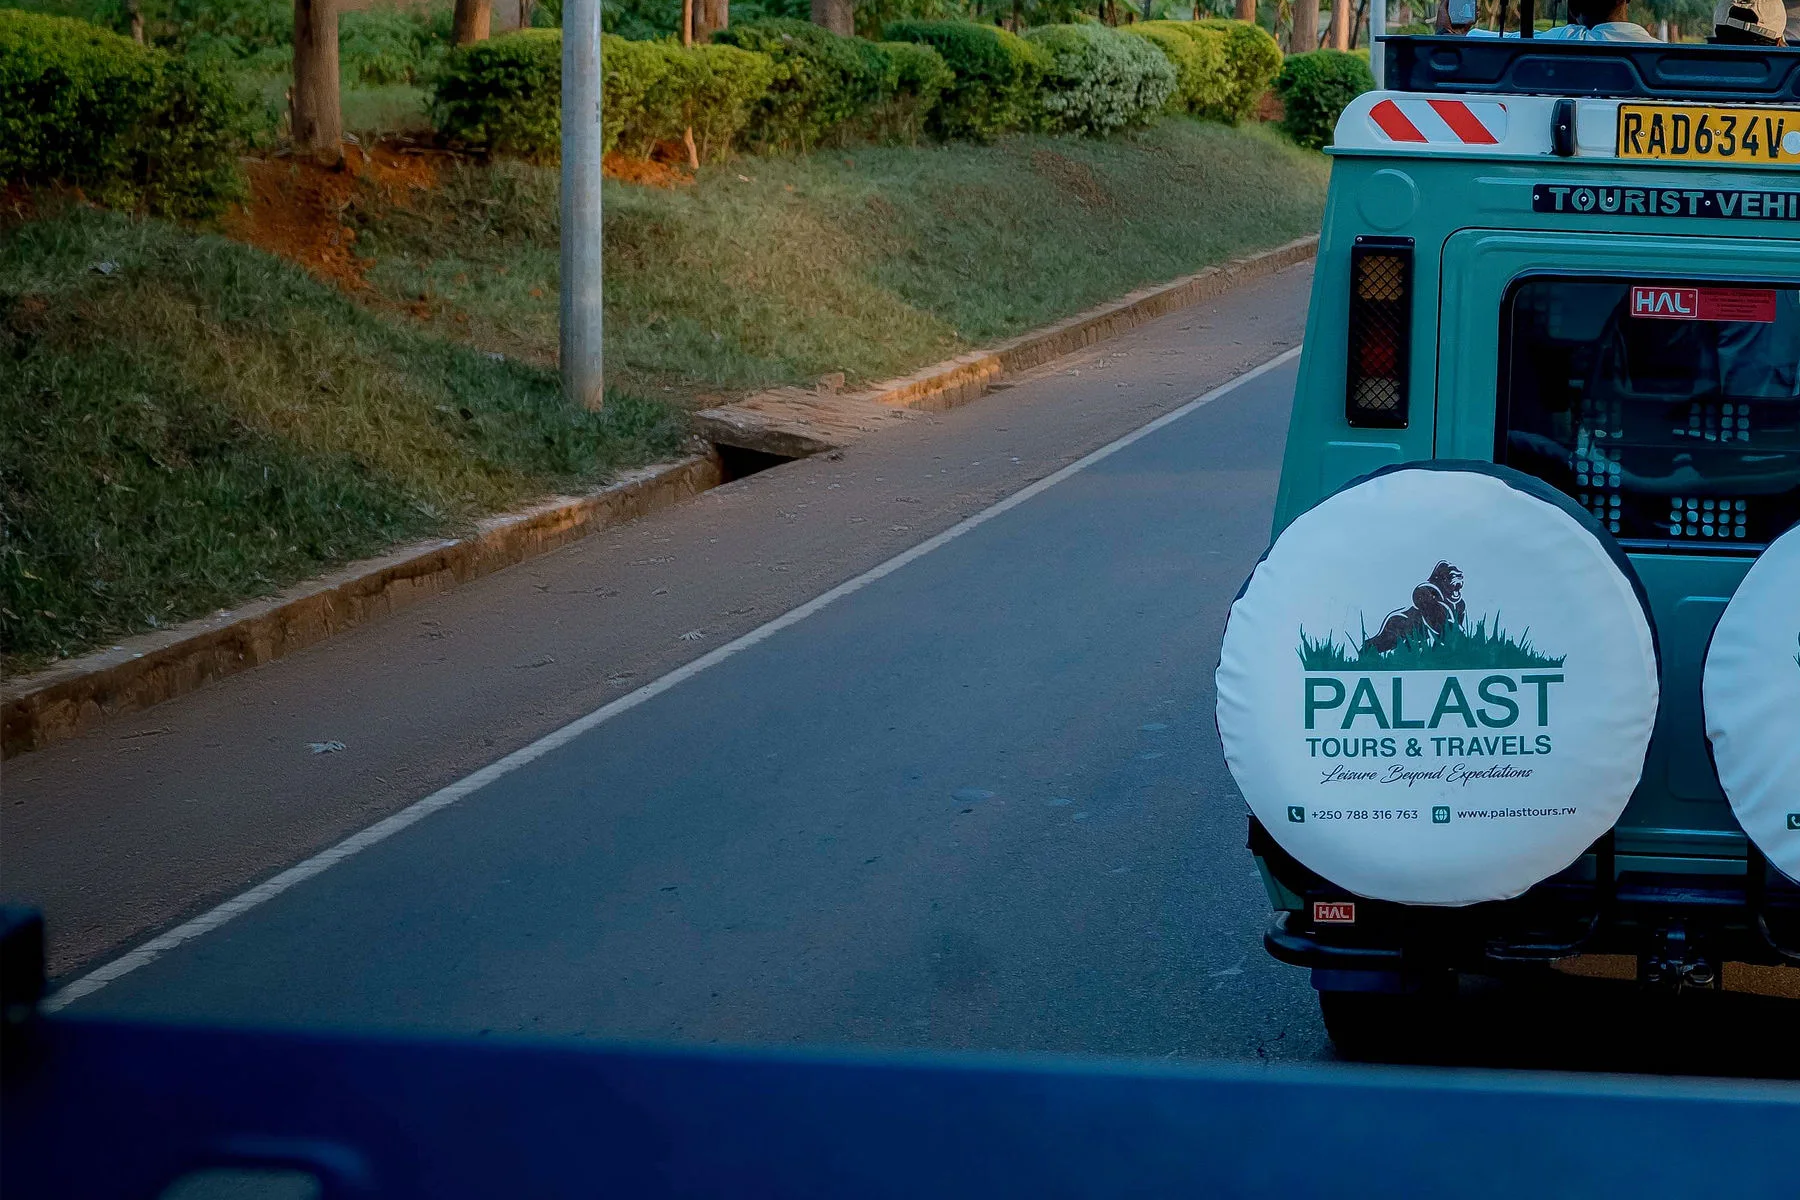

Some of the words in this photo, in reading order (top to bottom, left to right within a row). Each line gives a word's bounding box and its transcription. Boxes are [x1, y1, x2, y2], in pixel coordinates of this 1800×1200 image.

[1624, 113, 1784, 158] RAD634V
[1549, 187, 1704, 215] TOURIST
[1636, 291, 1691, 313] HAL
[1304, 674, 1564, 729] PALAST
[1306, 737, 1396, 757] TOURS
[1405, 738, 1423, 757] &
[1430, 735, 1552, 757] TRAVELS
[1320, 764, 1377, 784] Leisure
[1380, 764, 1446, 787] Beyond
[1446, 763, 1534, 786] Expectations
[1312, 810, 1342, 820] +250
[1346, 810, 1369, 820] 788
[1372, 810, 1392, 820] 316
[1396, 810, 1418, 820] 763
[1457, 806, 1577, 820] www.palasttours.rw
[1318, 906, 1349, 919] HAL
